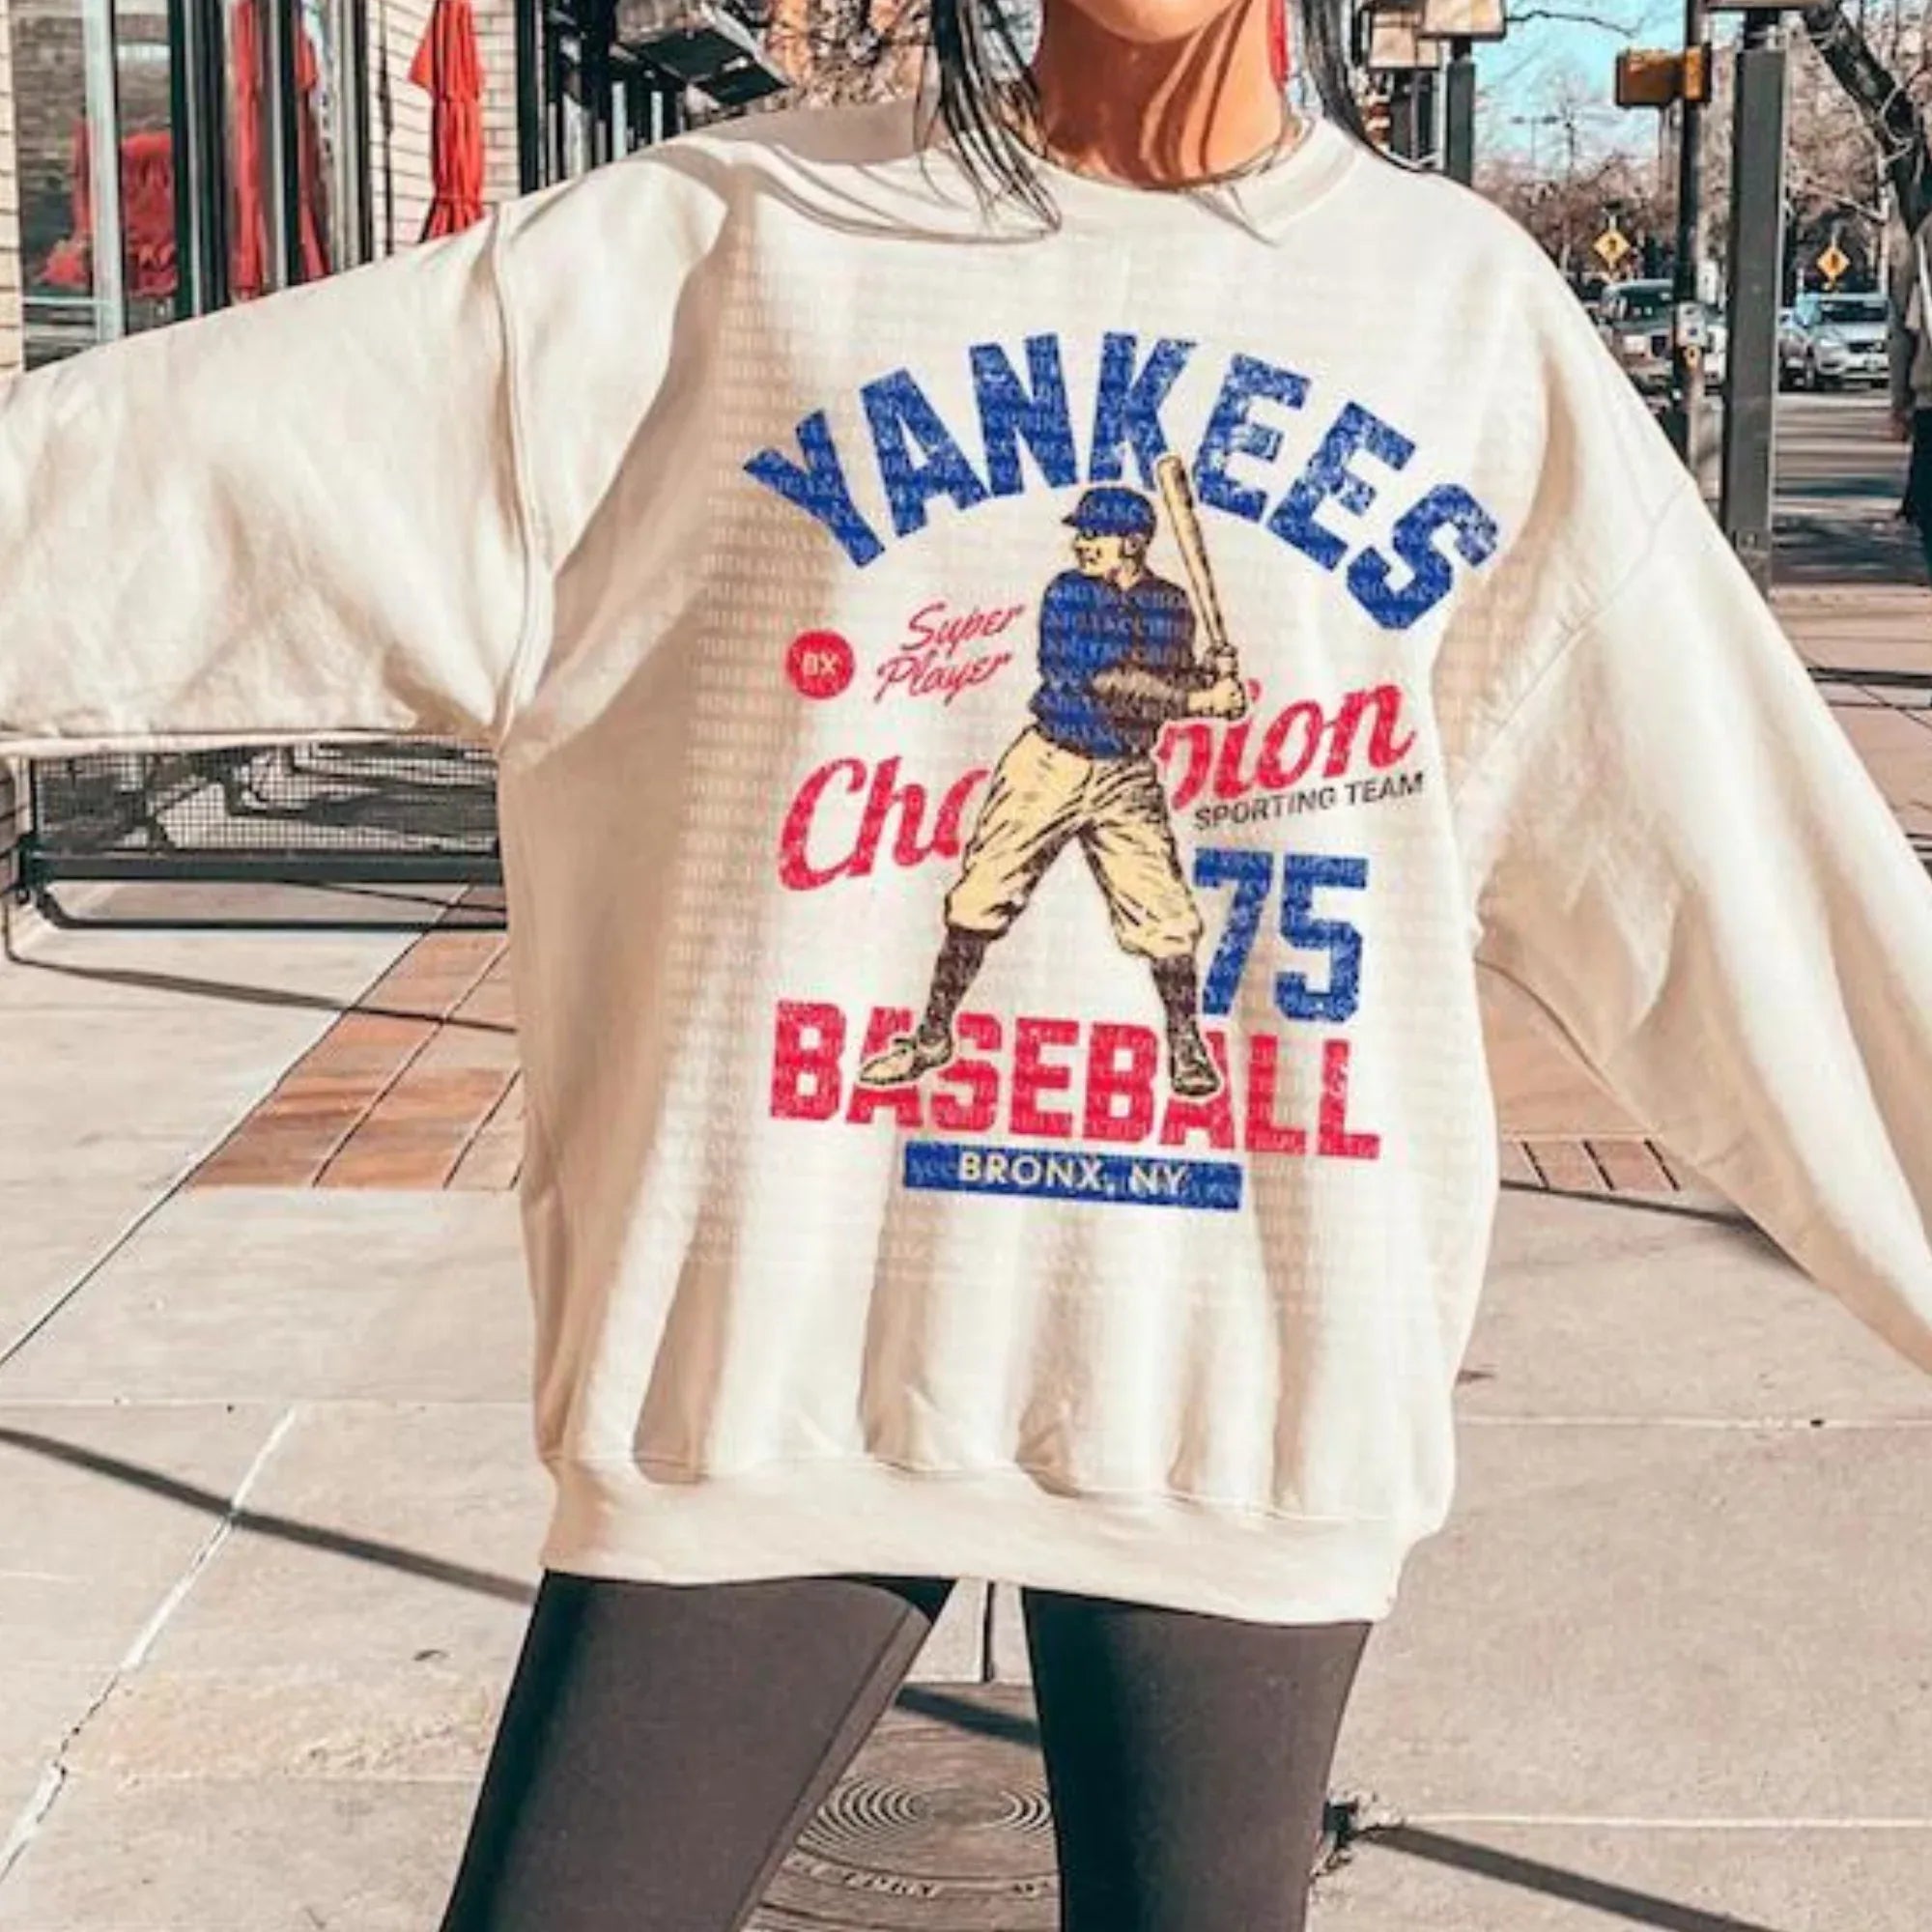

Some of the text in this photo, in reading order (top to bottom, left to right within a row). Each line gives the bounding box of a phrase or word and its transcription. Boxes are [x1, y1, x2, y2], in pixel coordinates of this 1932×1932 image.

[743, 331, 1498, 631] YANKEES
[873, 649, 1012, 707] Player
[900, 601, 1026, 658] Super
[779, 678, 1417, 891] Chion
[1193, 771, 1424, 831] SPORTING TEAM
[1193, 848, 1369, 1023] 75
[770, 1000, 1380, 1160] BASEBALL
[958, 1151, 1190, 1196] BRONX, NY
